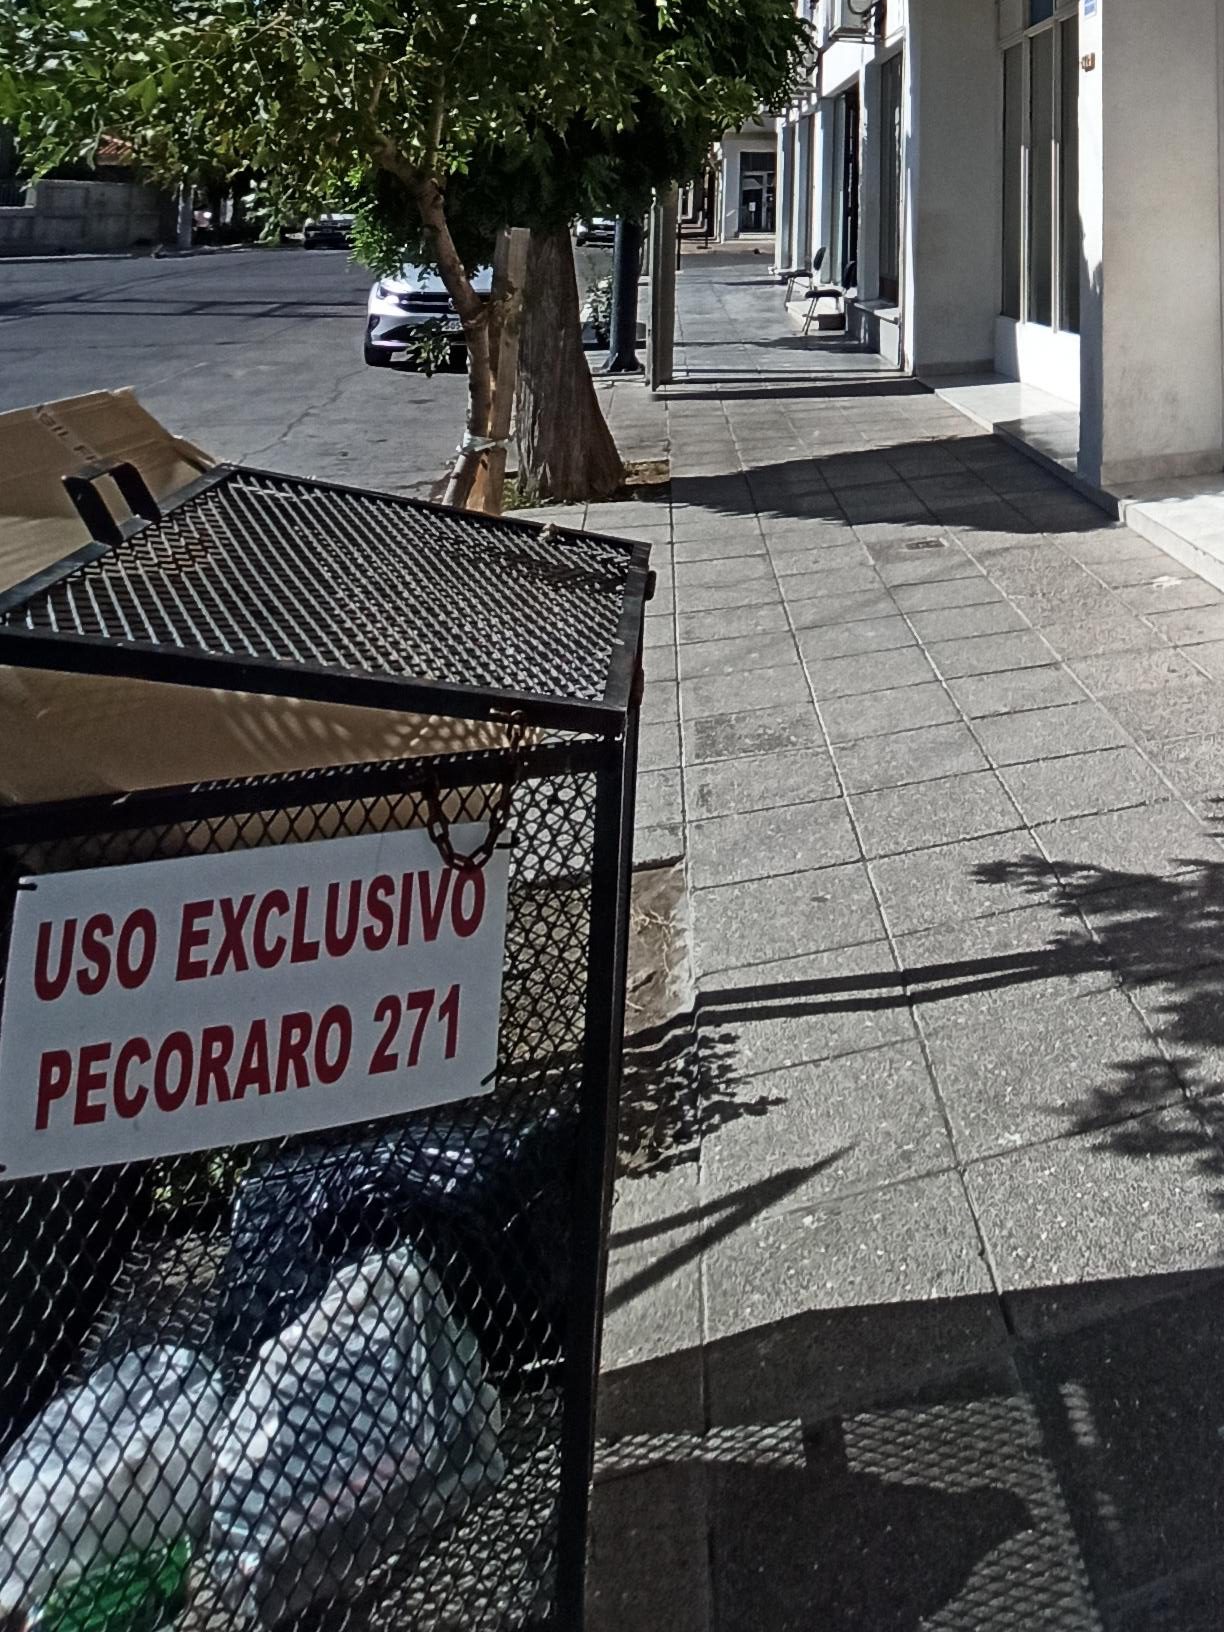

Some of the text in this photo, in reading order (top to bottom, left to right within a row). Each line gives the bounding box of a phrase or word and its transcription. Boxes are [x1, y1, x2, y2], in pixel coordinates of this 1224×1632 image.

[33, 866, 487, 1002] USO EXCLUSIVO
[34, 984, 462, 1131] PECORARO 271
